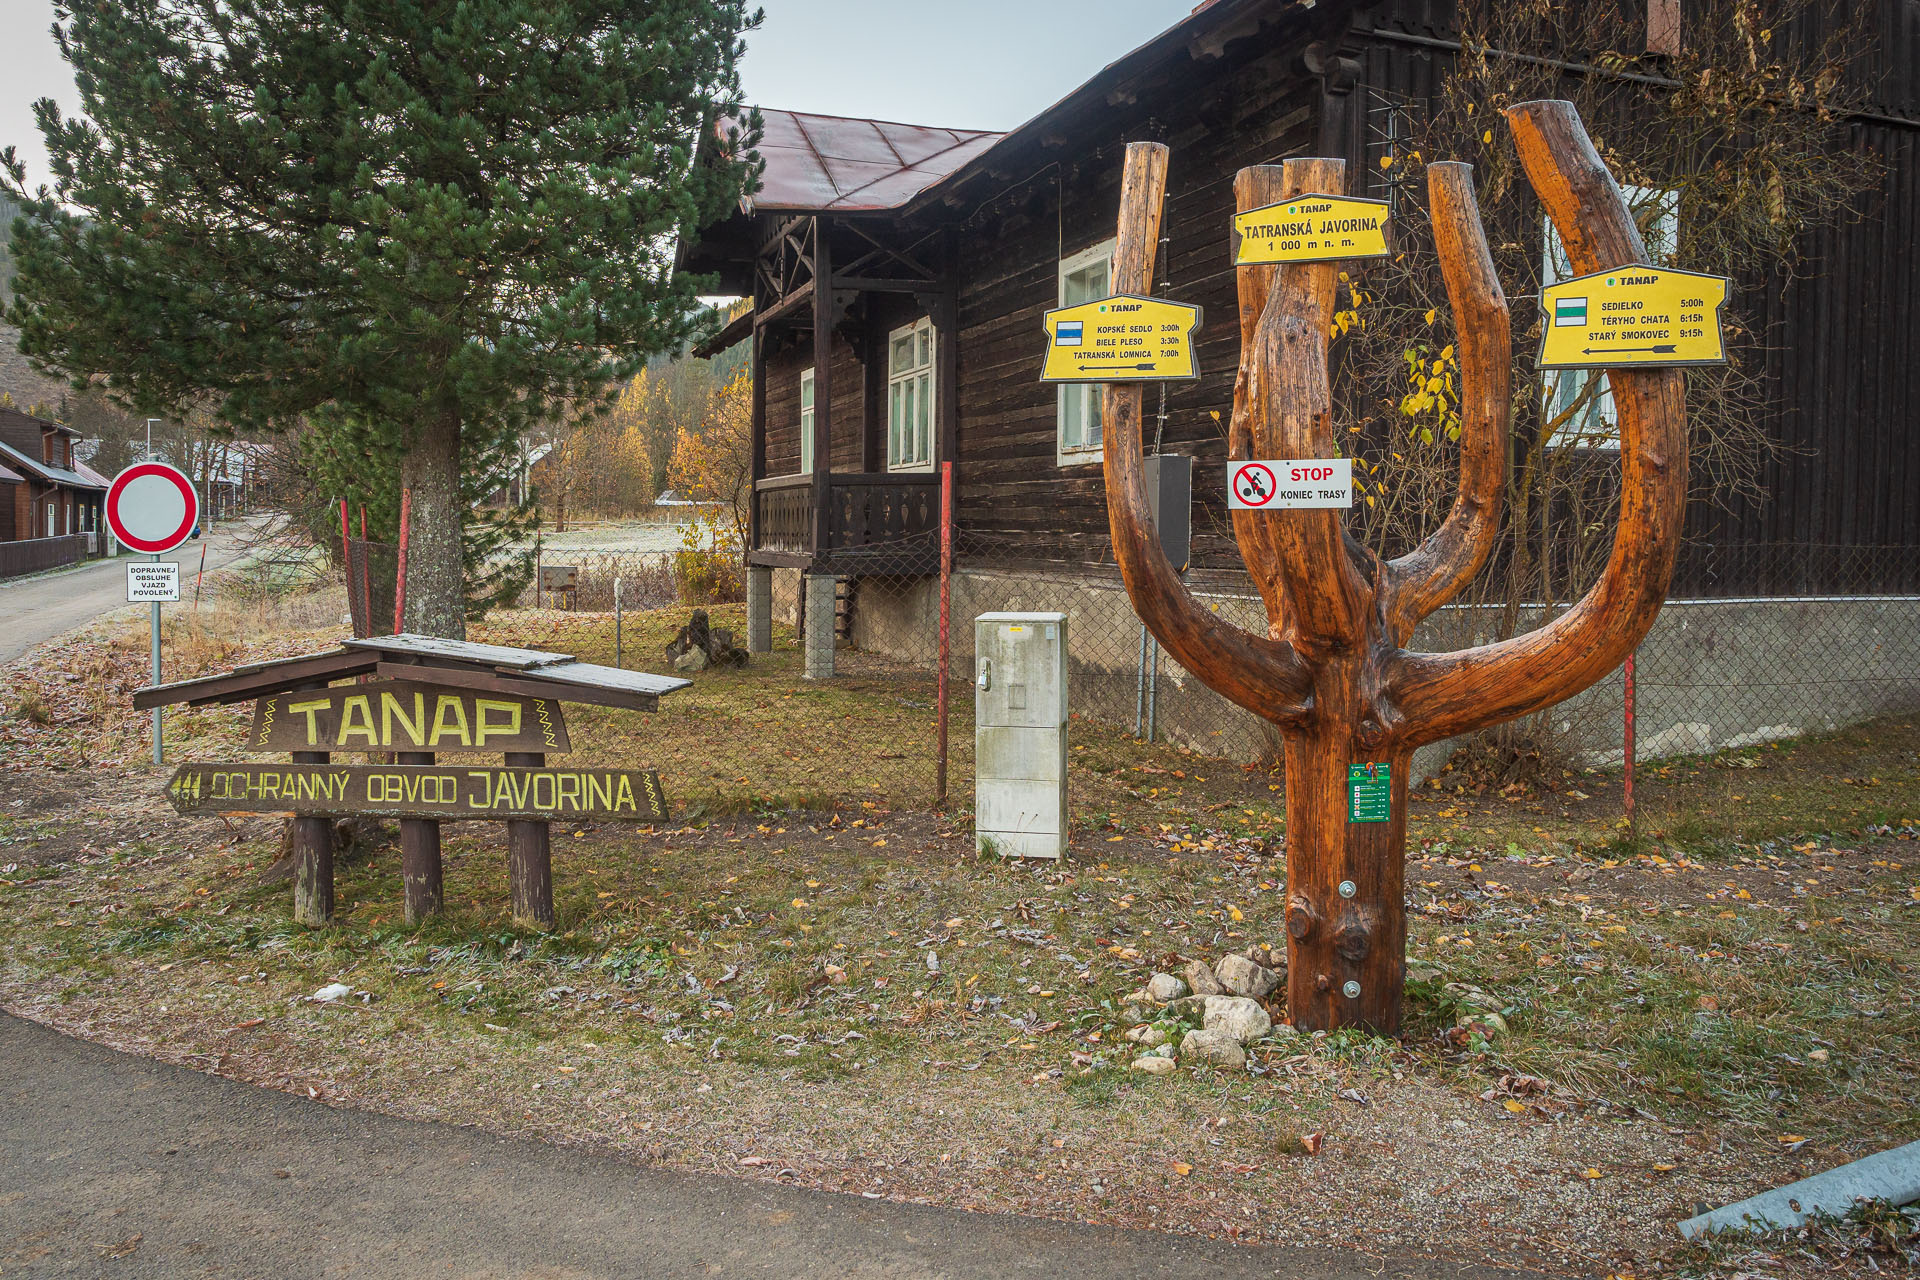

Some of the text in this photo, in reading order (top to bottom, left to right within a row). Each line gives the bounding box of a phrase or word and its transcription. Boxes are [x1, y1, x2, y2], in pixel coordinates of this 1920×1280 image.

[1300, 204, 1332, 213] TANAP
[1245, 218, 1378, 239] TATRANSKÁ JAVORINA
[1268, 242, 1273, 251] 1
[1281, 240, 1300, 250] 000
[1620, 276, 1659, 285] TANAP
[1110, 304, 1142, 312] TANAP
[1601, 299, 1704, 311] SEDIELKO 5:00h
[1601, 314, 1703, 326] TÉRYHO CHATA 6:15h
[1097, 324, 1126, 333] KOPSKÉ
[1588, 329, 1703, 340] STARÝ SMOKOVEC 9:15h
[1096, 338, 1116, 346] BIELE
[1074, 350, 1115, 359] TATRANSKÁ
[1291, 468, 1333, 481] STOP
[1281, 490, 1346, 499] KONIEC TRASY
[289, 692, 522, 746] TANAP
[210, 770, 637, 812] OCHRANNÝ OBVOD JAVORINA
